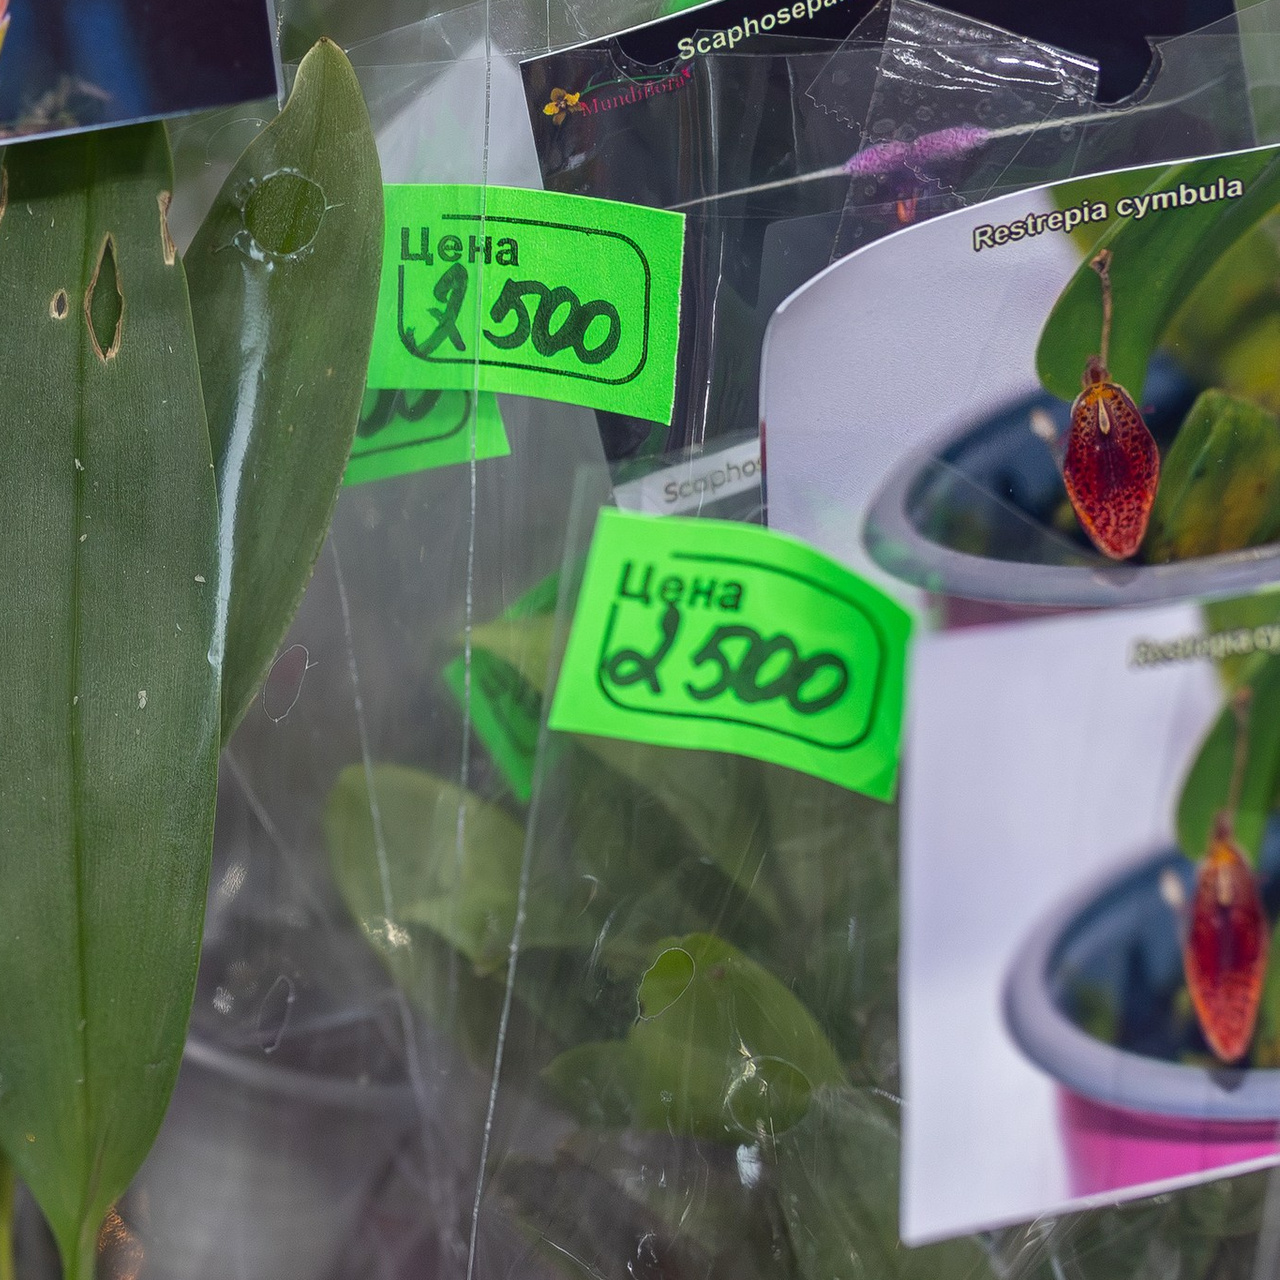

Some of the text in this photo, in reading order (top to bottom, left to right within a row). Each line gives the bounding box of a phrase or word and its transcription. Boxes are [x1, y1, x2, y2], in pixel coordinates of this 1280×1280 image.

[973, 177, 1245, 252] Restrepia cymbula
[400, 227, 520, 267] Цена
[664, 457, 761, 504] Scapho
[619, 561, 745, 612] Цена
[604, 604, 850, 716] 2500
